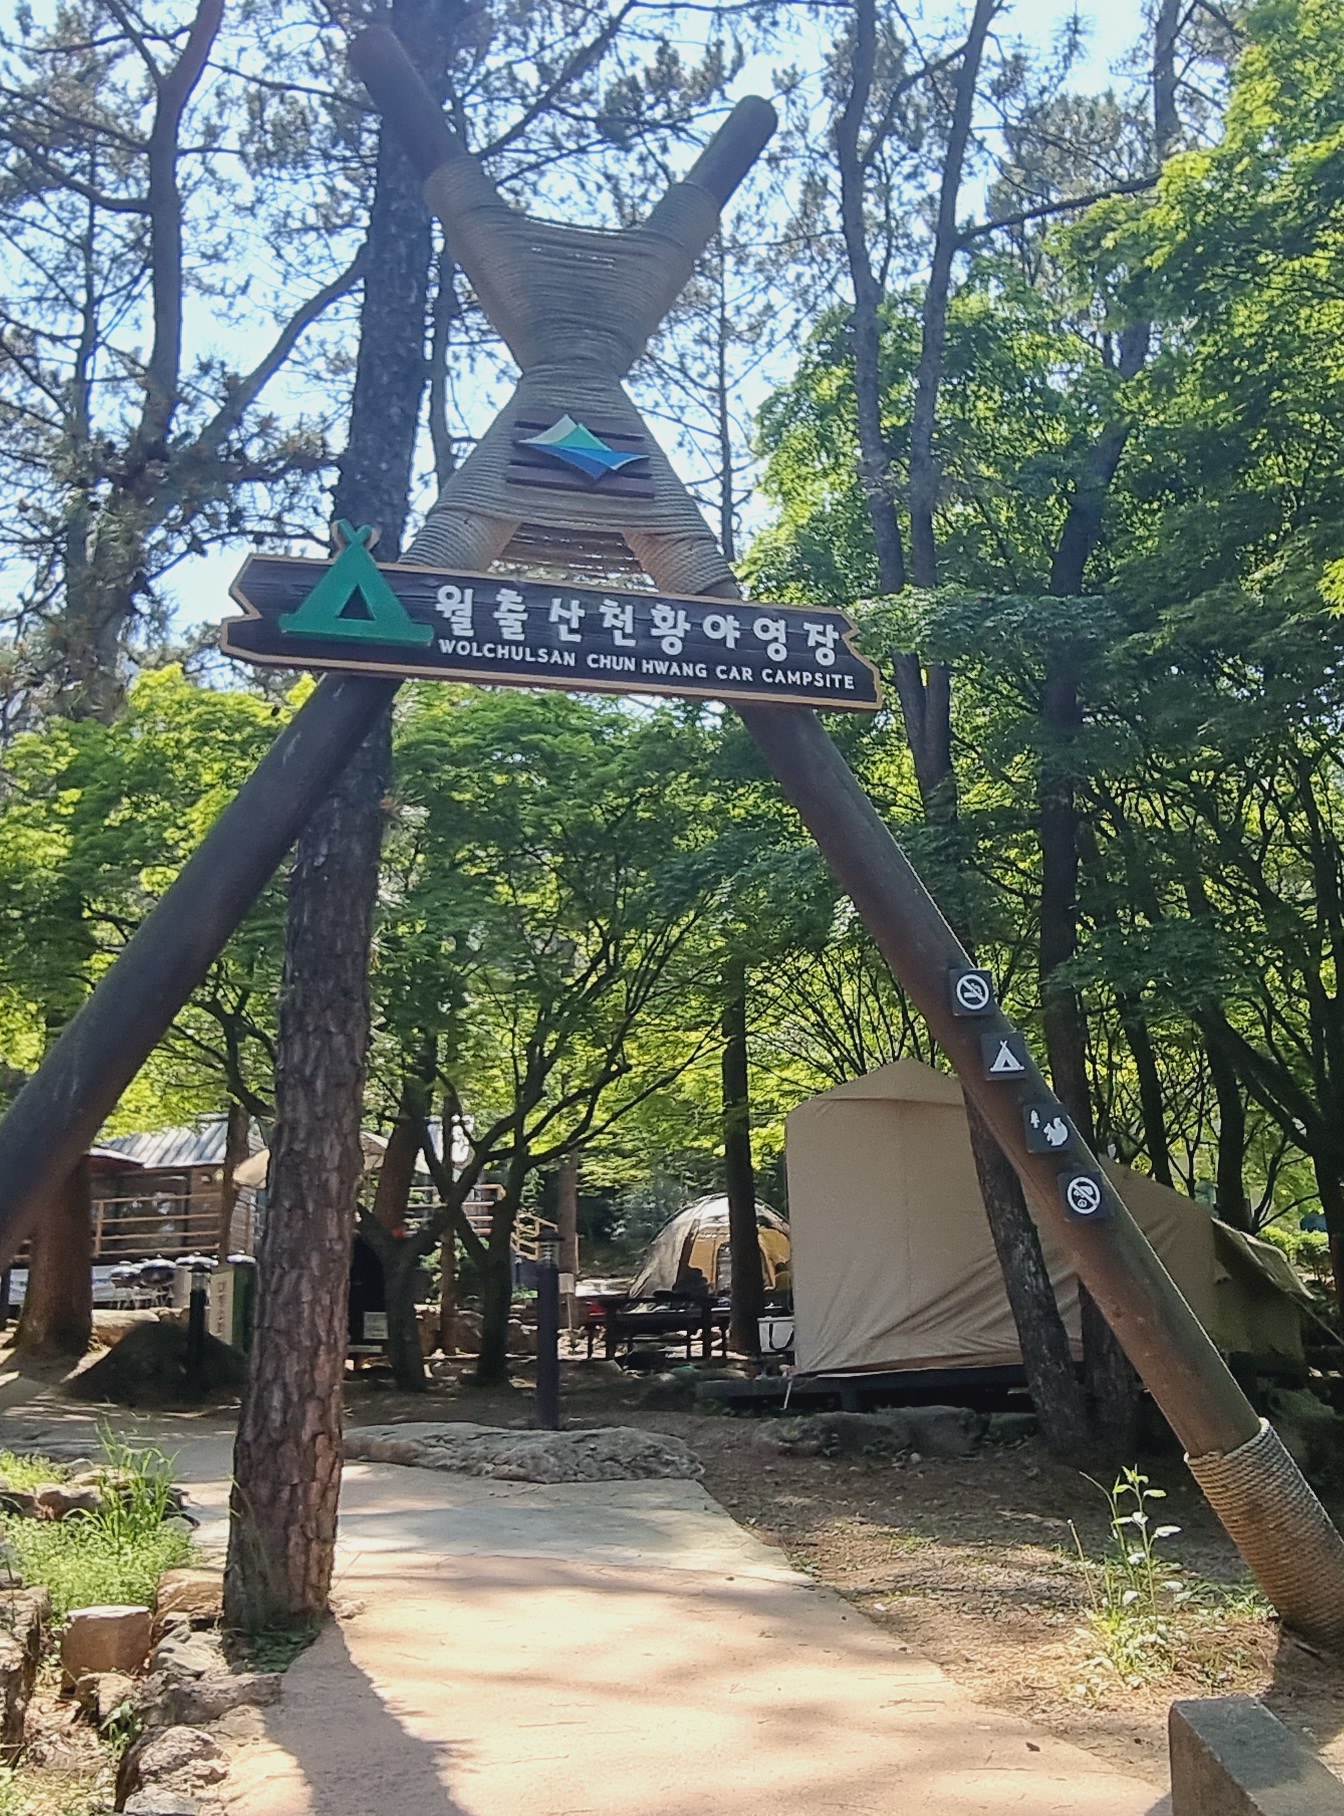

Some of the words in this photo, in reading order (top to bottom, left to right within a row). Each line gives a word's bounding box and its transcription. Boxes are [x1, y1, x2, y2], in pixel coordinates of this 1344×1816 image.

[438, 638, 576, 667] WOLCHULSAN
[586, 653, 636, 671] CHUN
[641, 659, 708, 678] HWANG
[715, 665, 754, 682] CAR
[761, 668, 855, 690] CAMPSITE
